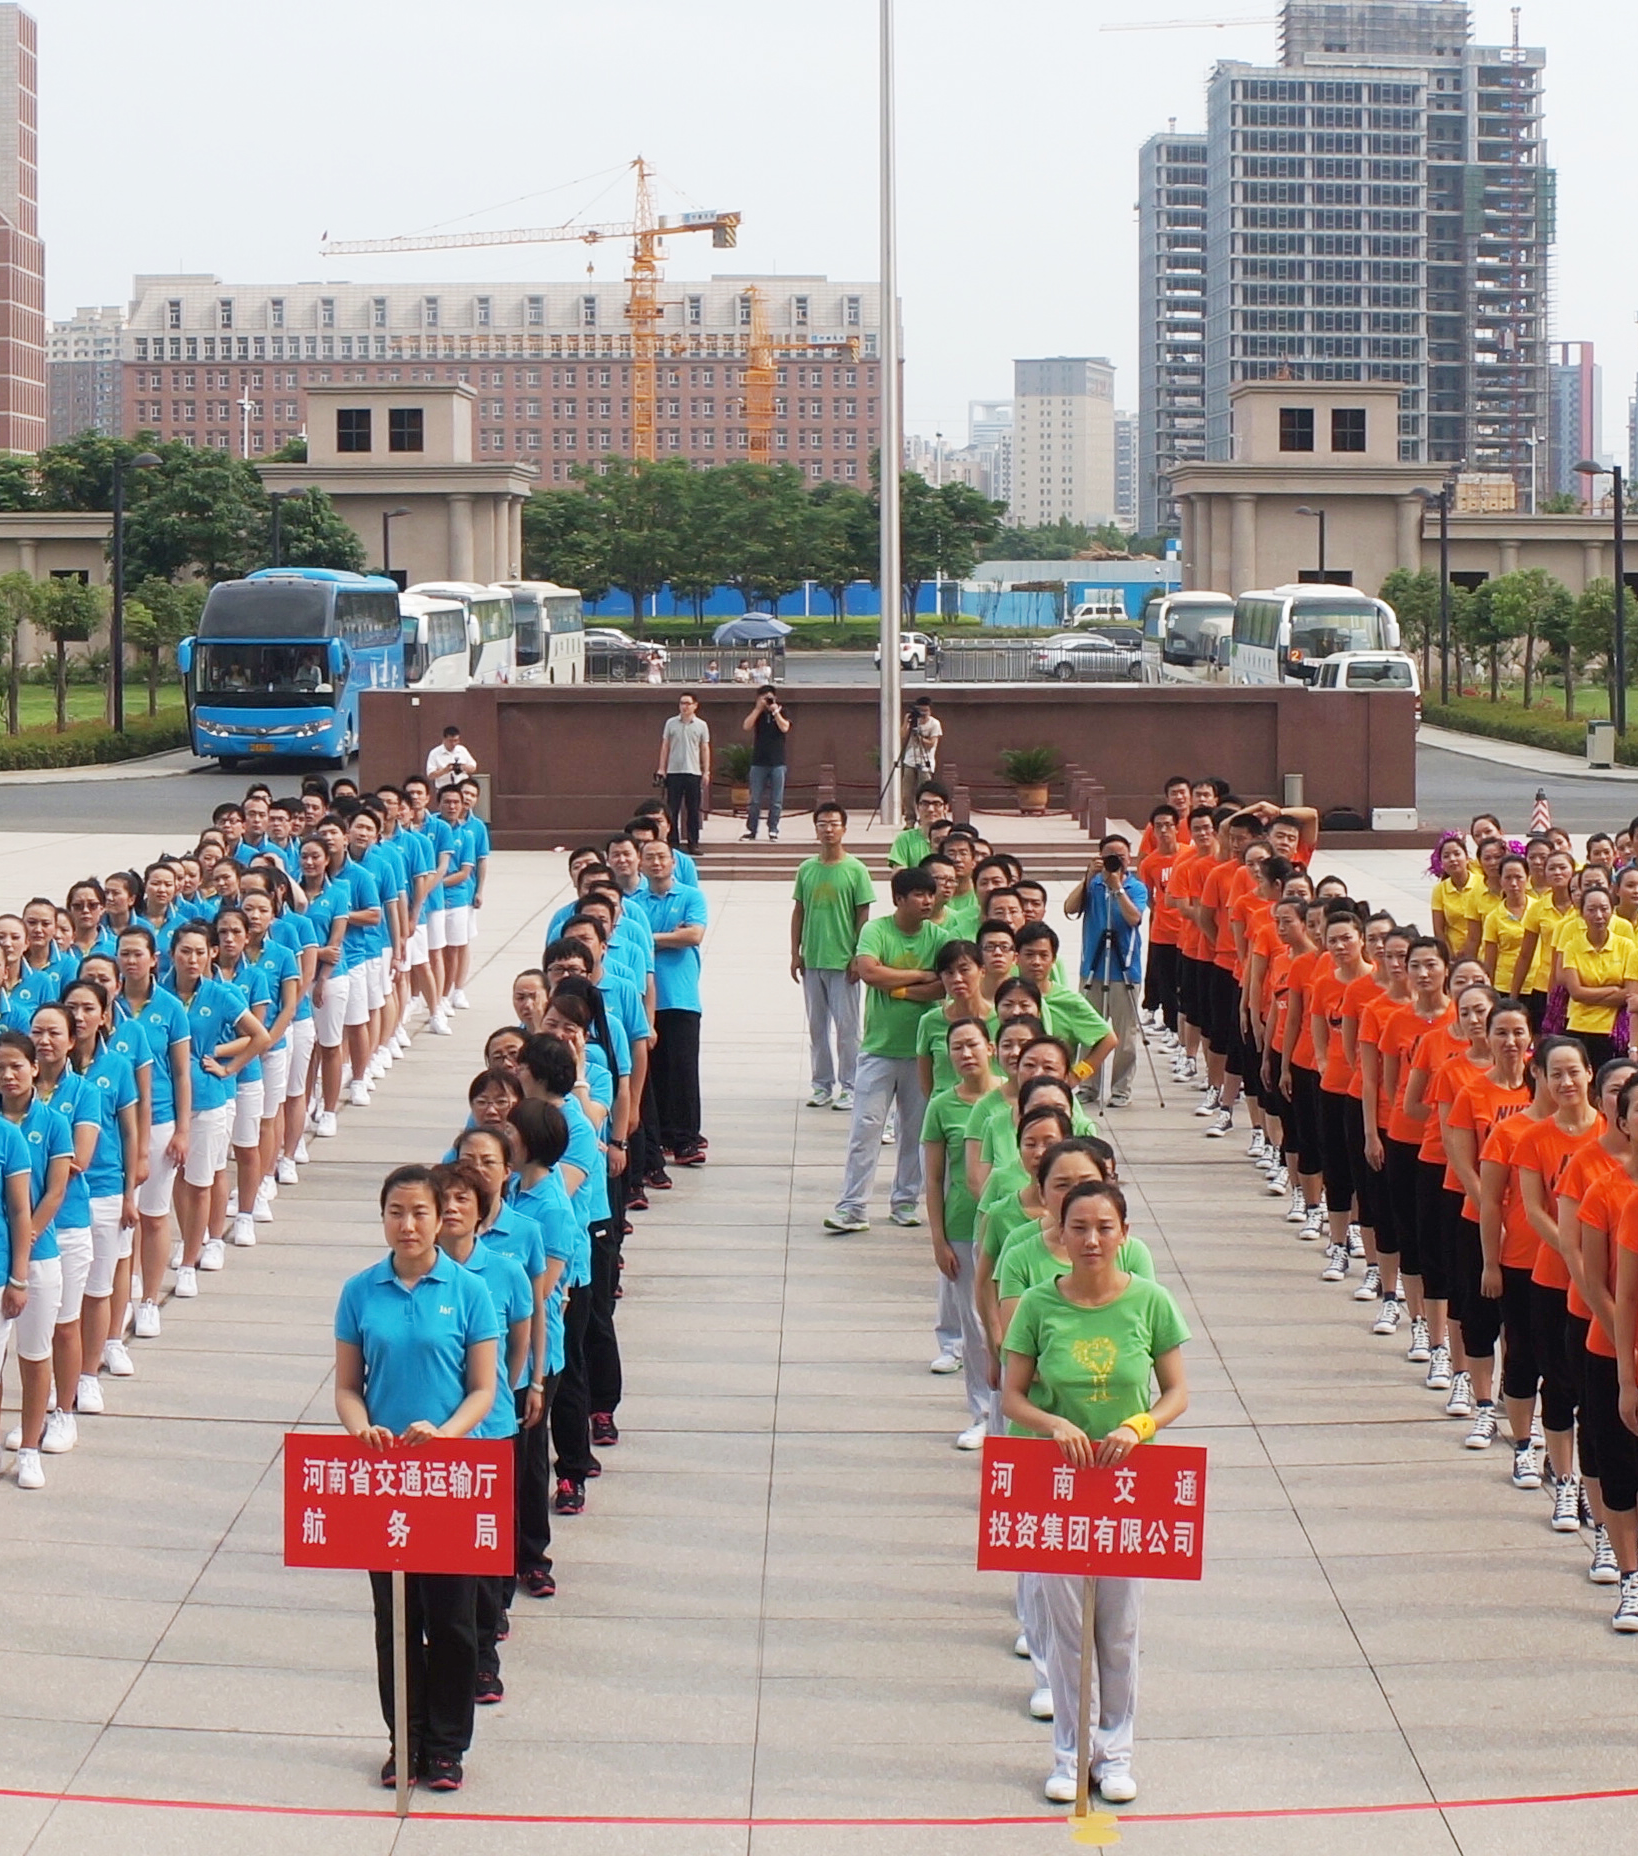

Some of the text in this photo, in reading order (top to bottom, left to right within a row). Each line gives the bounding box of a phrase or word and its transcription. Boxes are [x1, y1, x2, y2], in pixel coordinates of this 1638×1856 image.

[1291, 649, 1301, 661] 2
[302, 1457, 498, 1499] 河南省交通运输厅
[990, 1460, 1197, 1506] 河南交通
[302, 1507, 498, 1550] 航务局
[988, 1510, 1195, 1558] 投资集团有限公司
